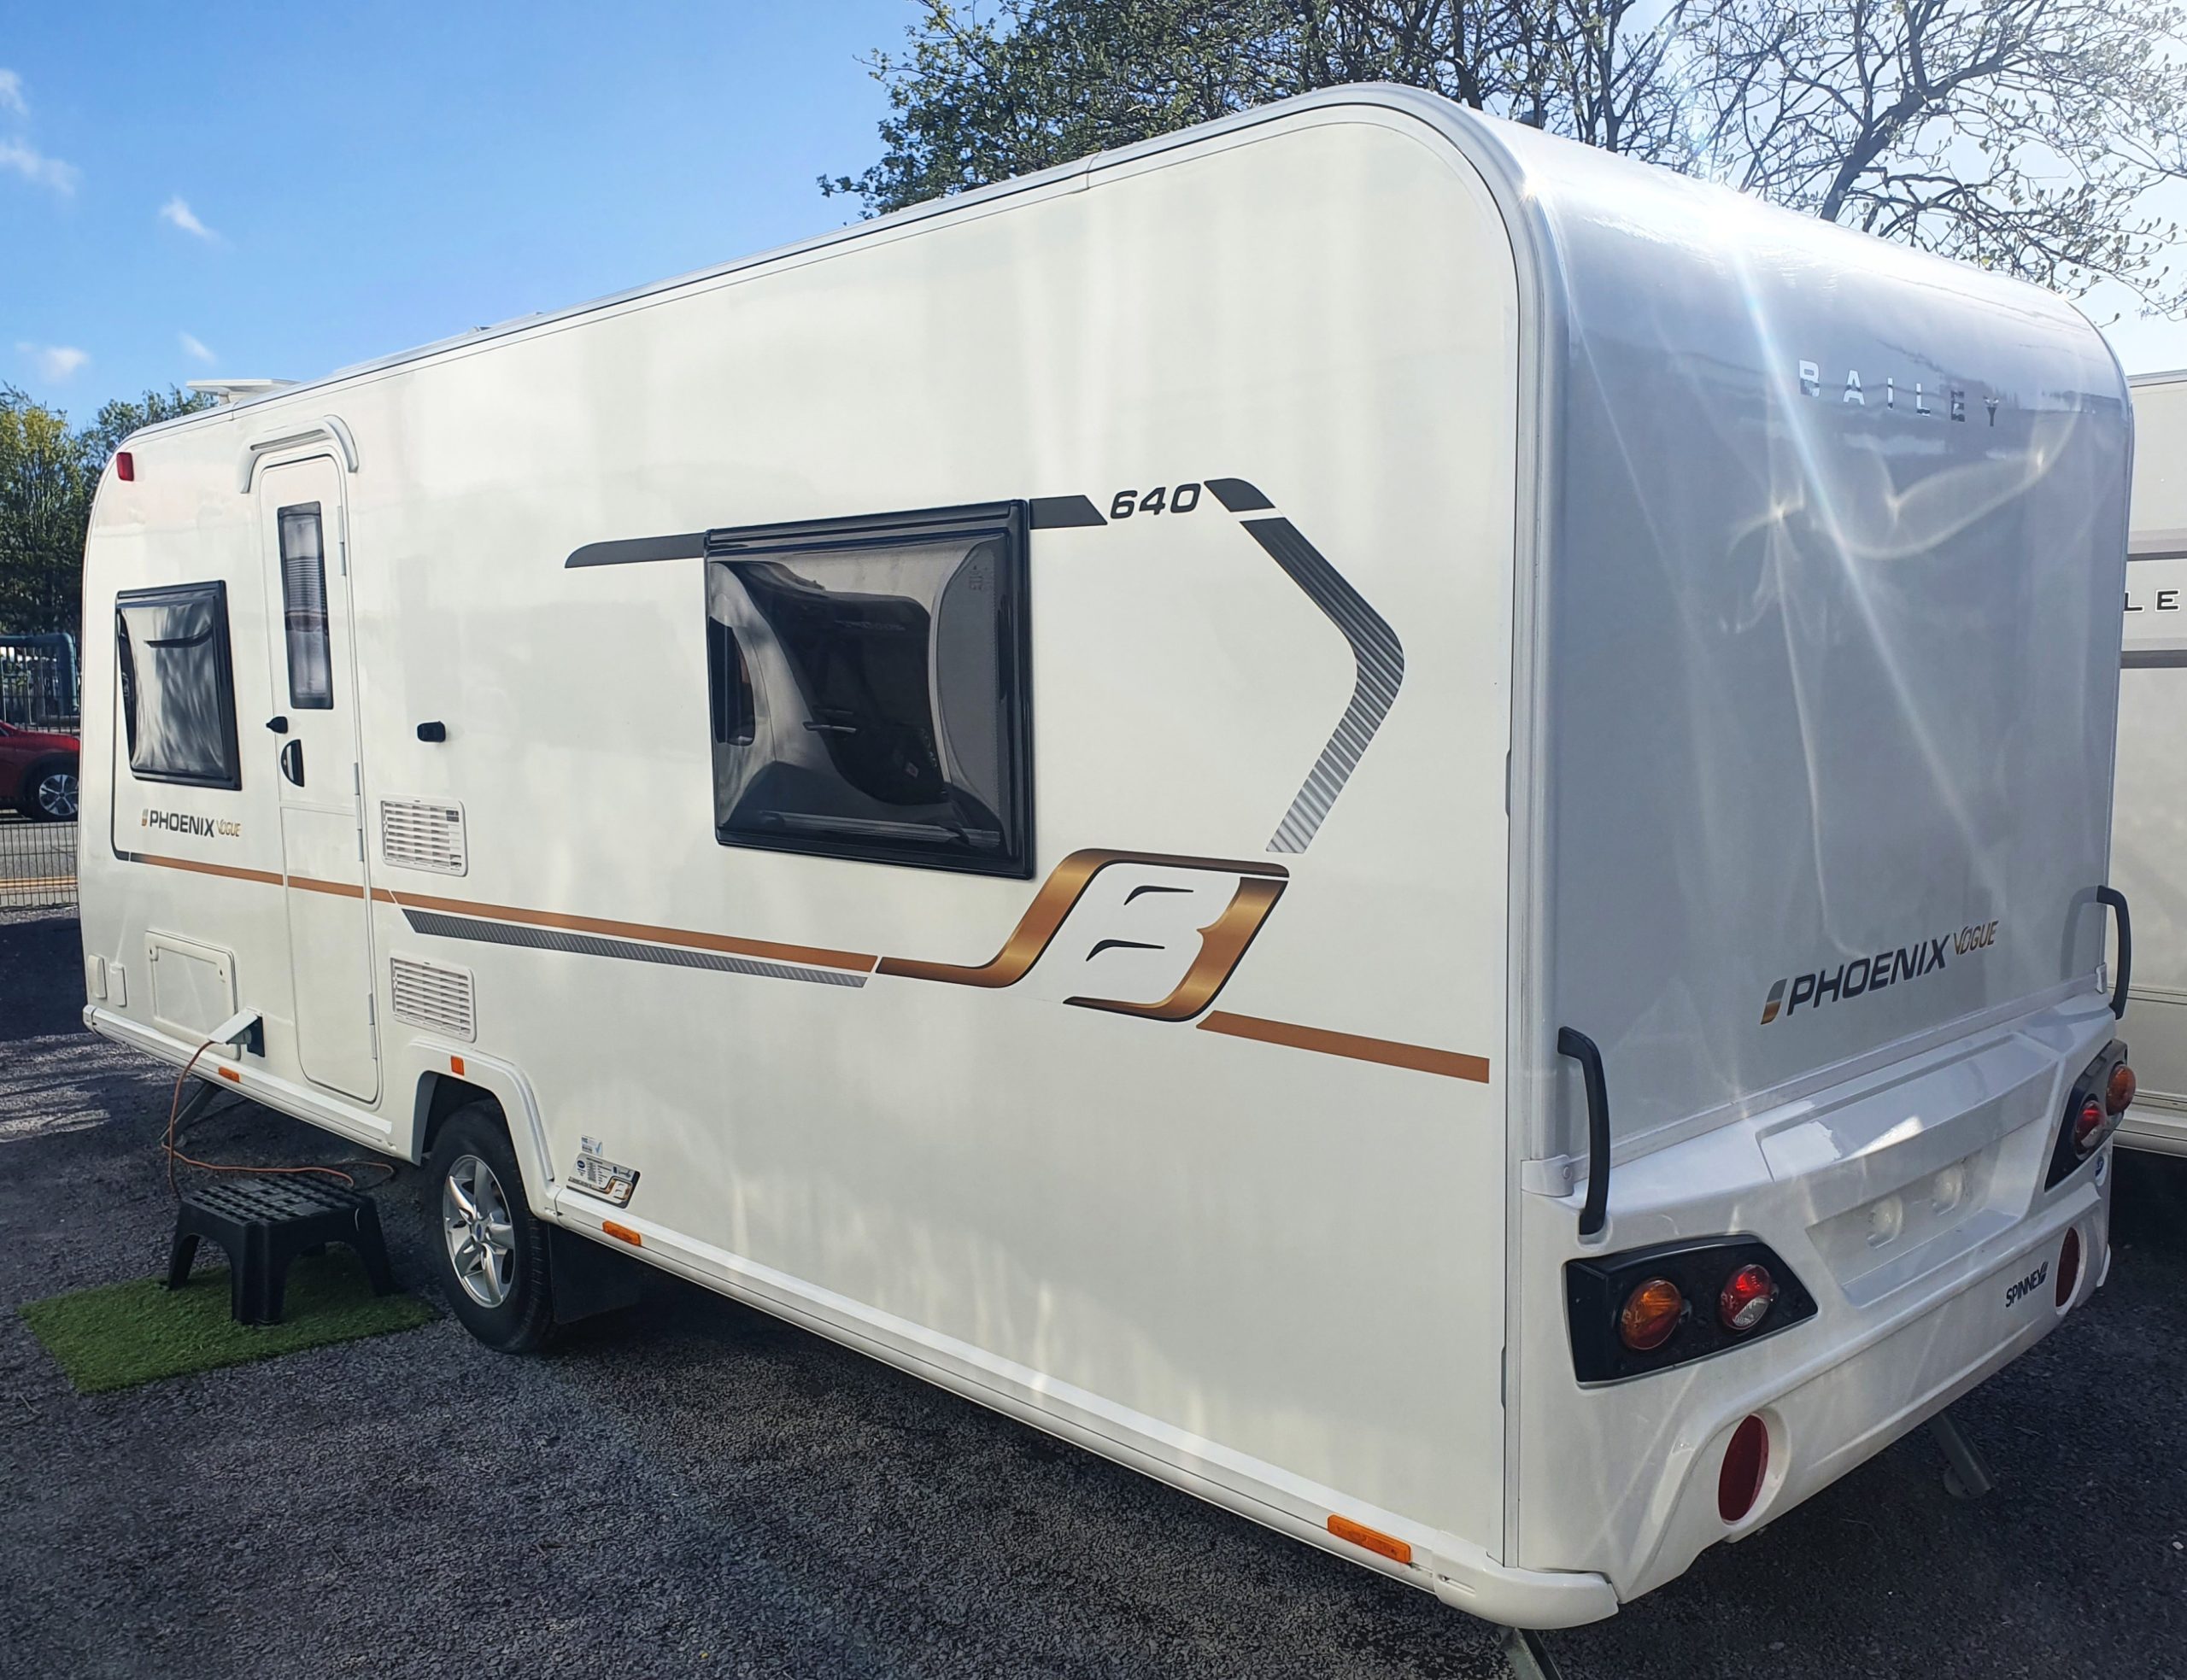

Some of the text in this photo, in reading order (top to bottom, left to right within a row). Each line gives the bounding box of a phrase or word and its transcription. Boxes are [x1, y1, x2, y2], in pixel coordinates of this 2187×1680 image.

[1798, 359, 1999, 427] BAILEY
[1111, 483, 1201, 519] 640
[150, 809, 241, 838] PHOENIX VOGUE
[1786, 920, 2000, 1016] PHOENIX VOGUE
[2005, 1261, 2049, 1308] SPINNEY
